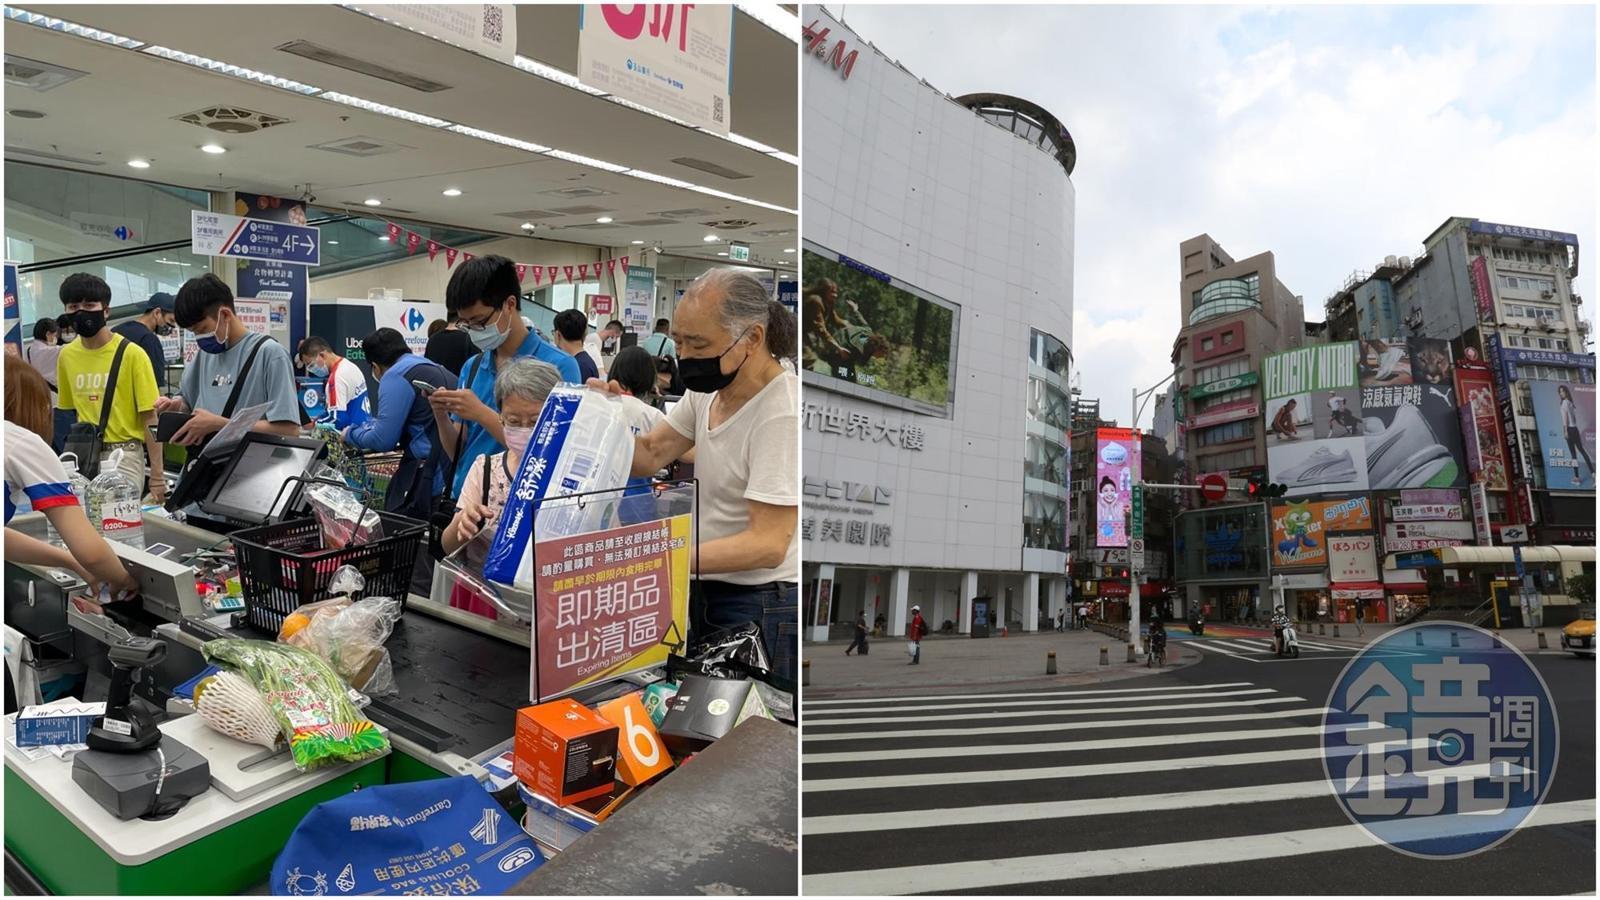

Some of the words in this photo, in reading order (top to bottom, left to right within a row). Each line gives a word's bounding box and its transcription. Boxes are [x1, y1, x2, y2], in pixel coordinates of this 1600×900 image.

[802, 19, 859, 80] H&M
[282, 235, 299, 252] 4F
[345, 337, 363, 348] Ube
[1264, 348, 1316, 399] VELOCITY
[1318, 343, 1354, 389] NITRO
[515, 456, 547, 501] 舒潔
[556, 574, 660, 630] 即期品
[556, 611, 660, 669] 出清區
[577, 659, 610, 677] Expiring
[611, 651, 633, 664] Items
[623, 704, 660, 767] 6
[404, 798, 452, 827] Carrefour
[373, 842, 466, 882] 僅供店內使用
[418, 863, 471, 884] COOLING
[391, 879, 417, 890] BAG
